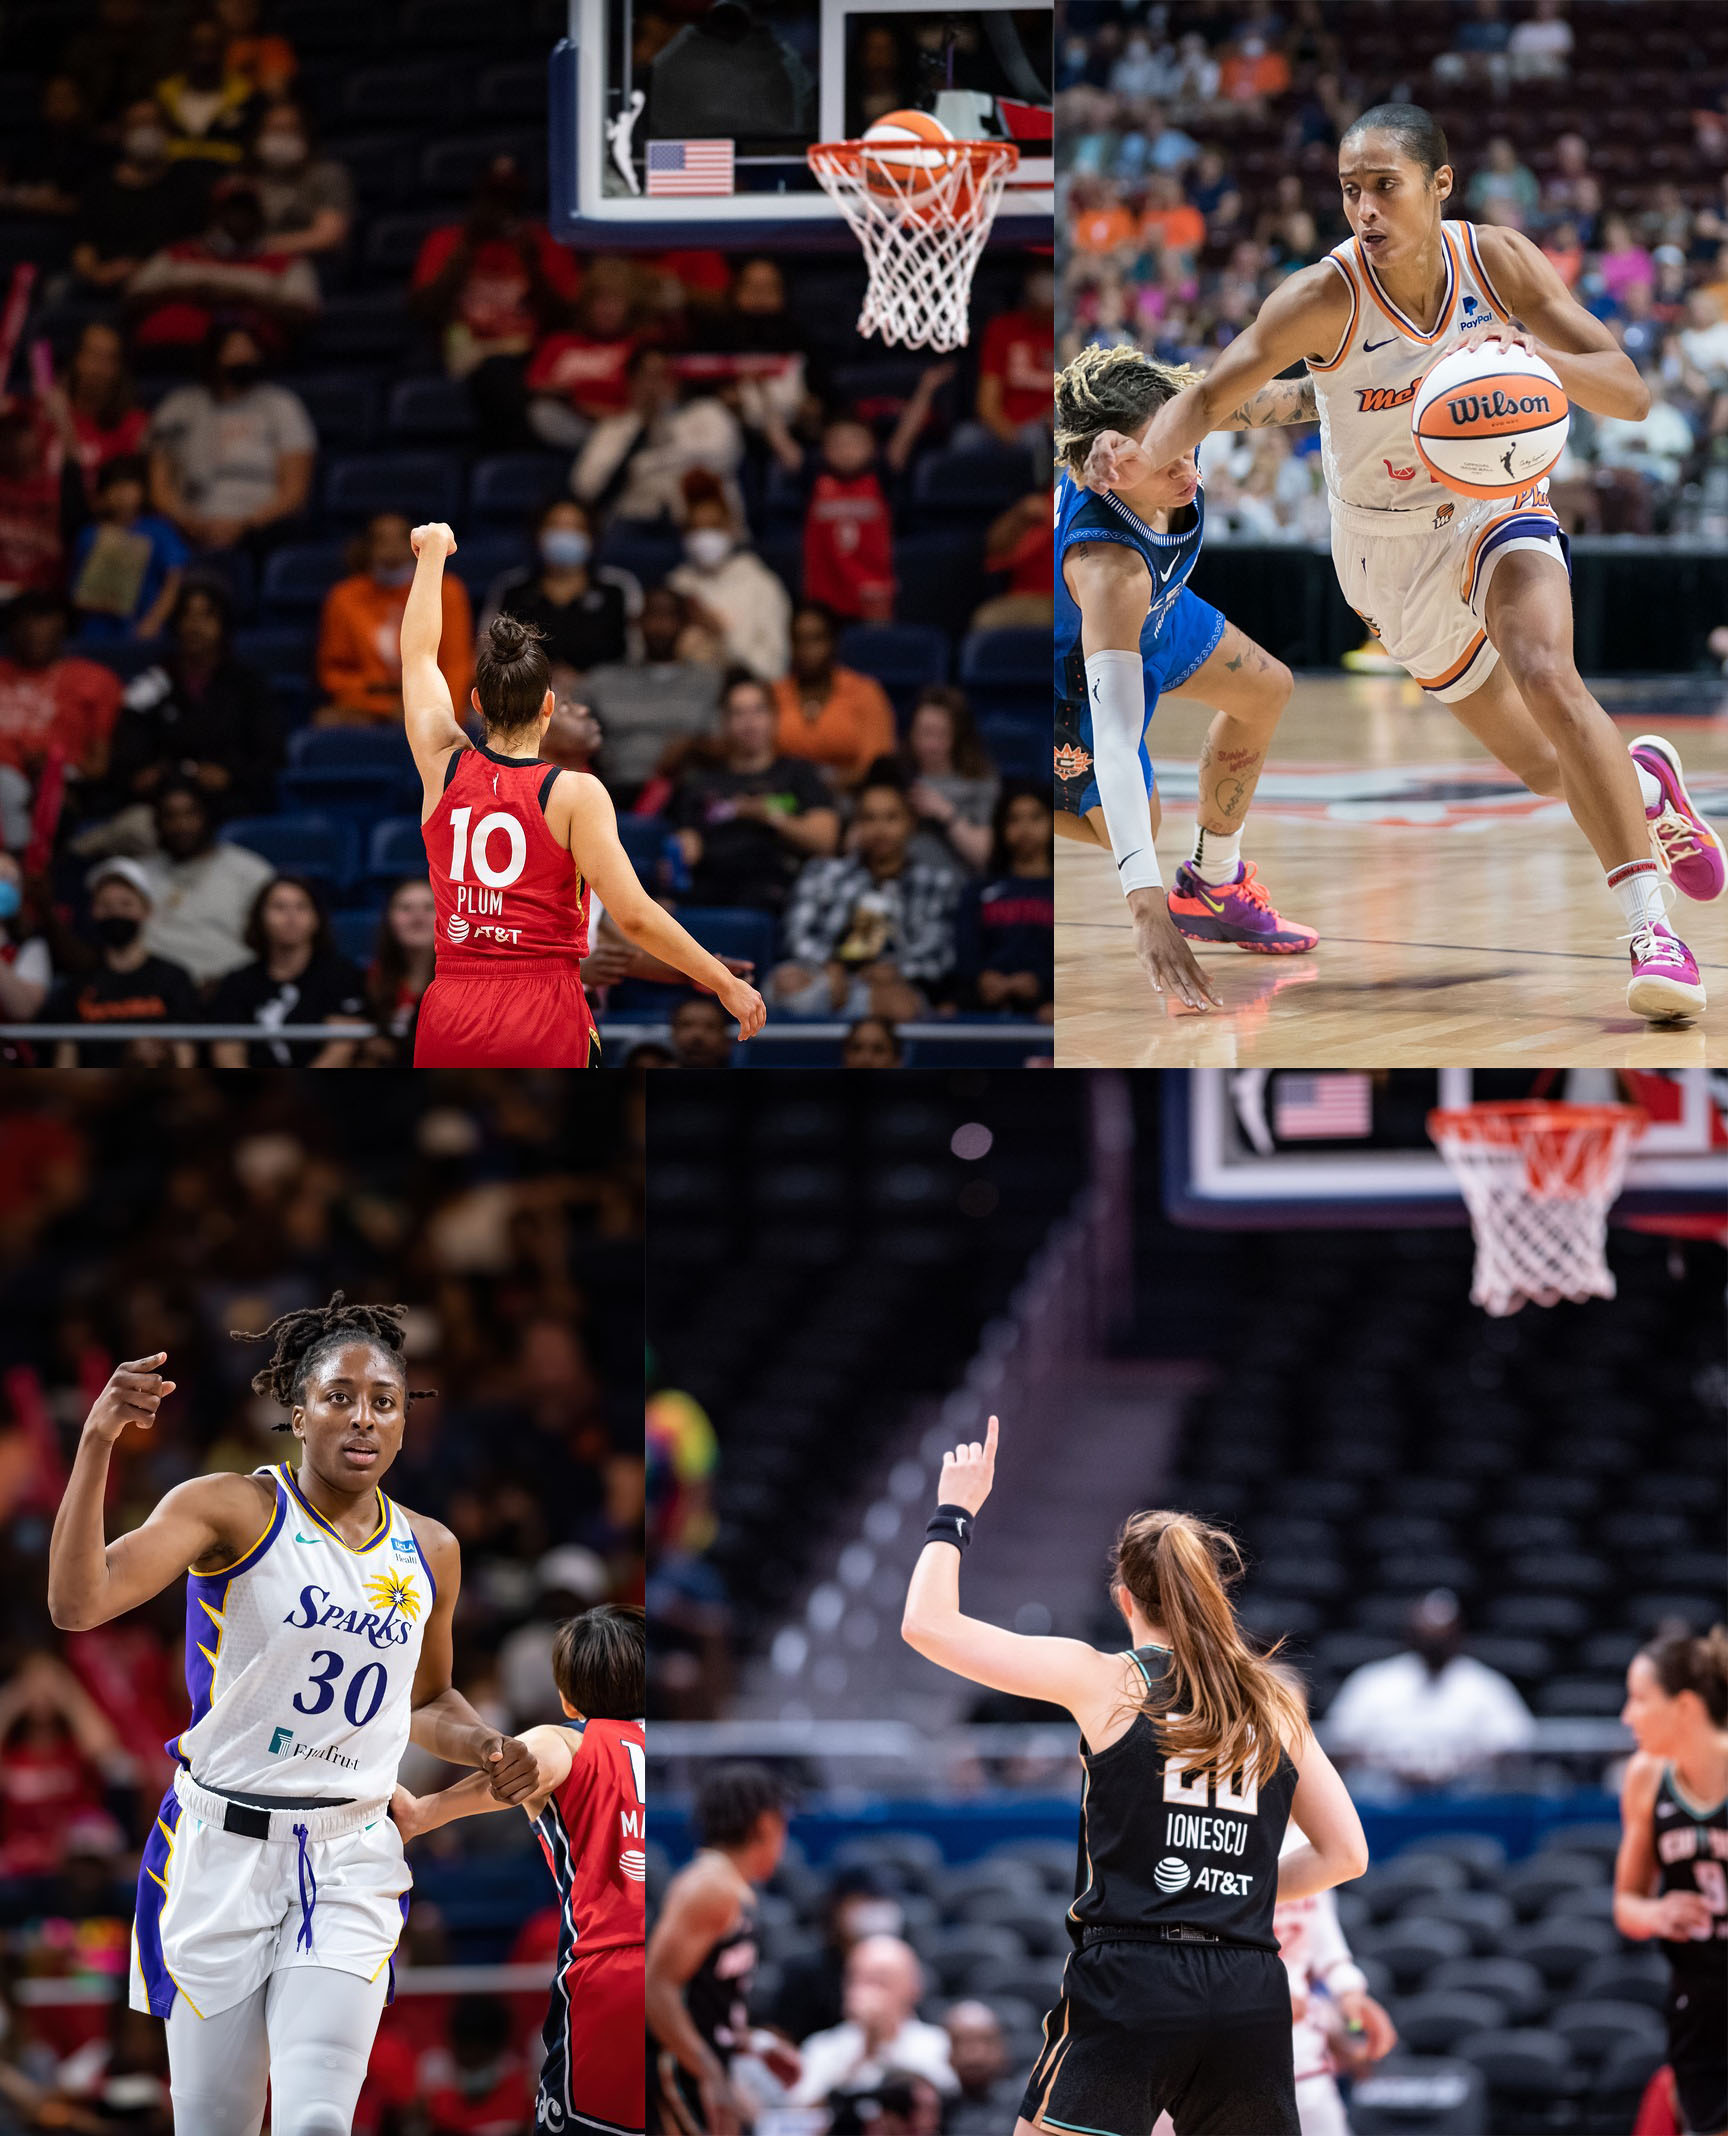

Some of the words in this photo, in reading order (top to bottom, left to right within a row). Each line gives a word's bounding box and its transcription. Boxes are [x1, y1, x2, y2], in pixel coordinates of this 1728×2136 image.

[1460, 311, 1493, 332] PayPal
[1447, 390, 1551, 426] Wilson
[449, 806, 527, 888] 10
[457, 885, 504, 916] PLUM
[473, 925, 523, 945] AT&T
[292, 1649, 388, 1727] 30
[1165, 1812, 1248, 1857] IONESCU
[1193, 1866, 1254, 1897] AT&T
